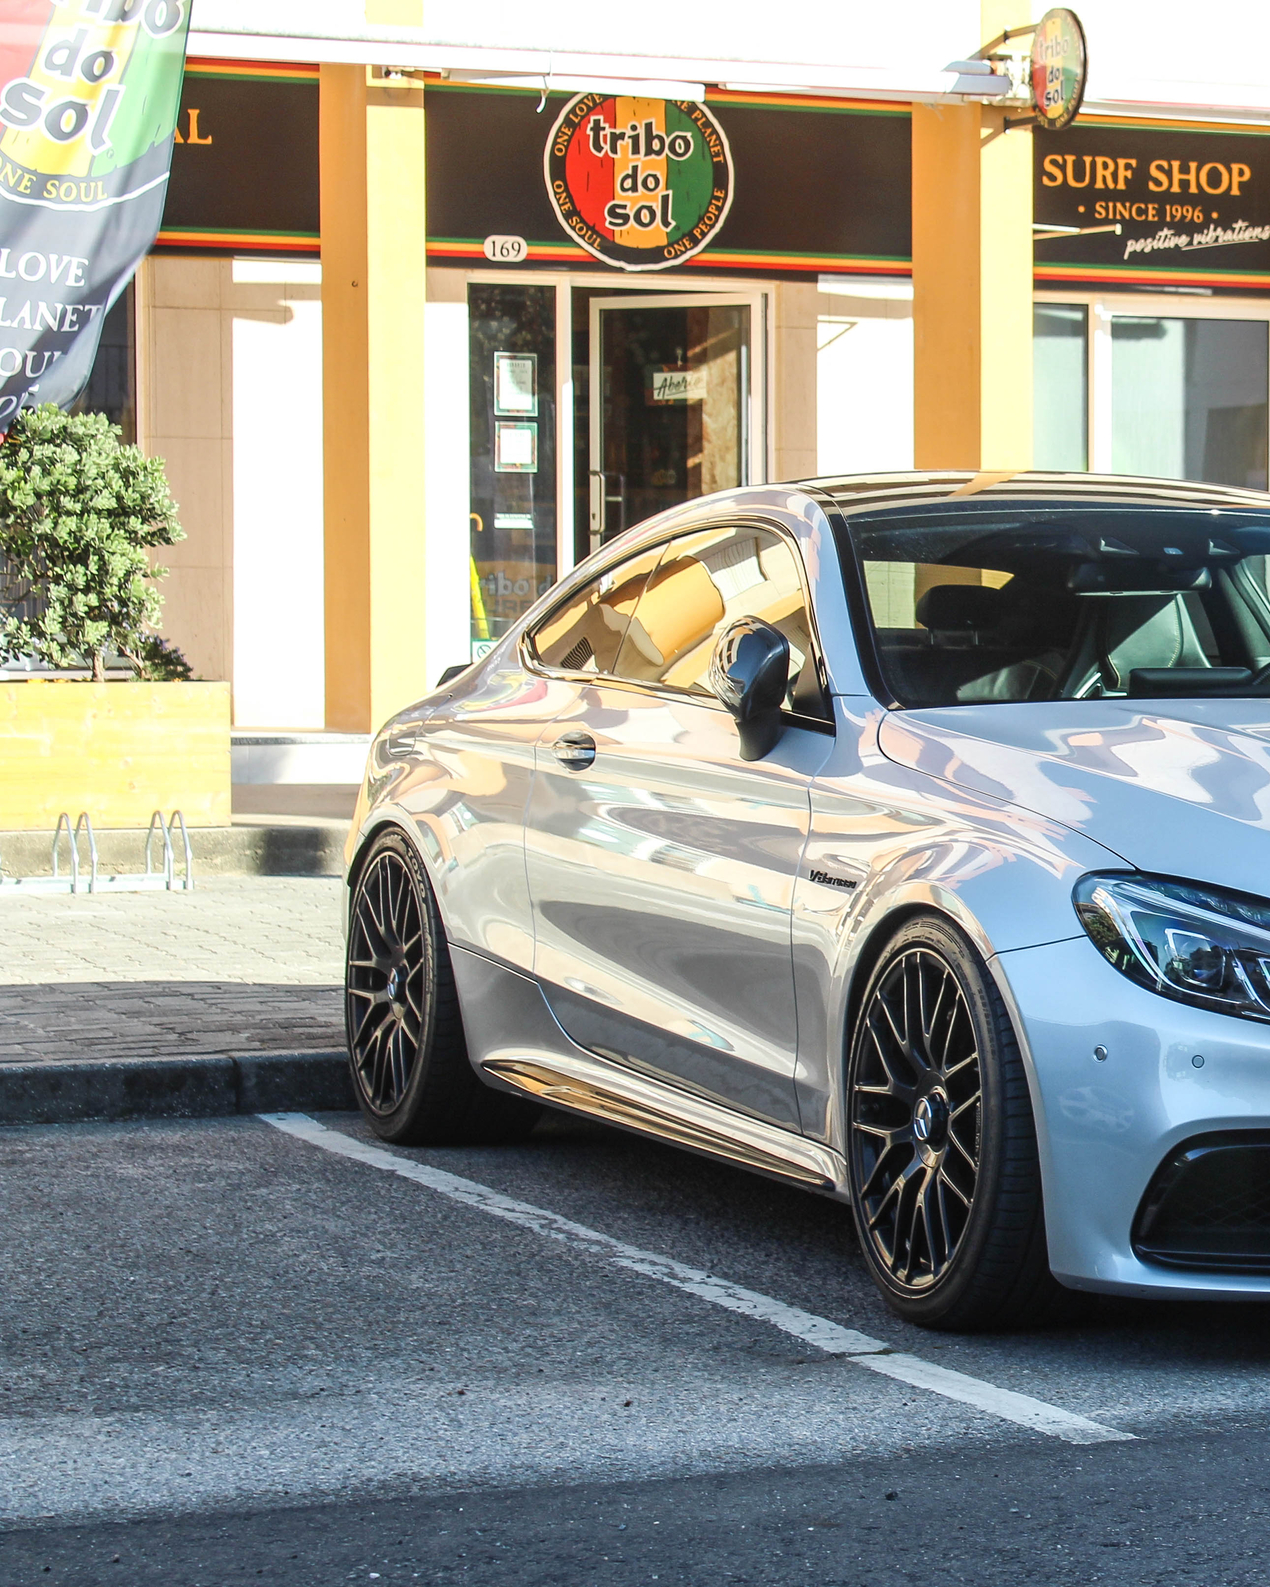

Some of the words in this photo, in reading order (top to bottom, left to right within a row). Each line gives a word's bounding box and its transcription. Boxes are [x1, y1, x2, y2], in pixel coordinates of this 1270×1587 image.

[42, 26, 116, 83] do
[1039, 35, 1069, 60] tribo
[1044, 79, 1065, 107] sol
[1048, 65, 1060, 83] do
[0, 81, 122, 153] sol
[554, 124, 573, 157] ONE
[569, 94, 603, 123] LOVE
[691, 110, 724, 163] PLANET
[588, 116, 693, 159] tribo
[0, 157, 37, 194] NE
[43, 180, 108, 202] SOUL
[619, 163, 661, 195] do
[1042, 154, 1137, 190] SURF
[1148, 159, 1251, 196] SHOP
[553, 180, 573, 213] ONE
[568, 216, 601, 250] SOUL
[605, 191, 674, 230] sol
[663, 236, 693, 259] ONE
[693, 187, 726, 240] PEOPLE
[1094, 201, 1159, 222] SINCE
[1165, 204, 1204, 223] 1996
[491, 239, 522, 259] 169
[1123, 227, 1189, 261] positive
[0, 248, 89, 287] LOVE
[0, 297, 104, 332] LANET
